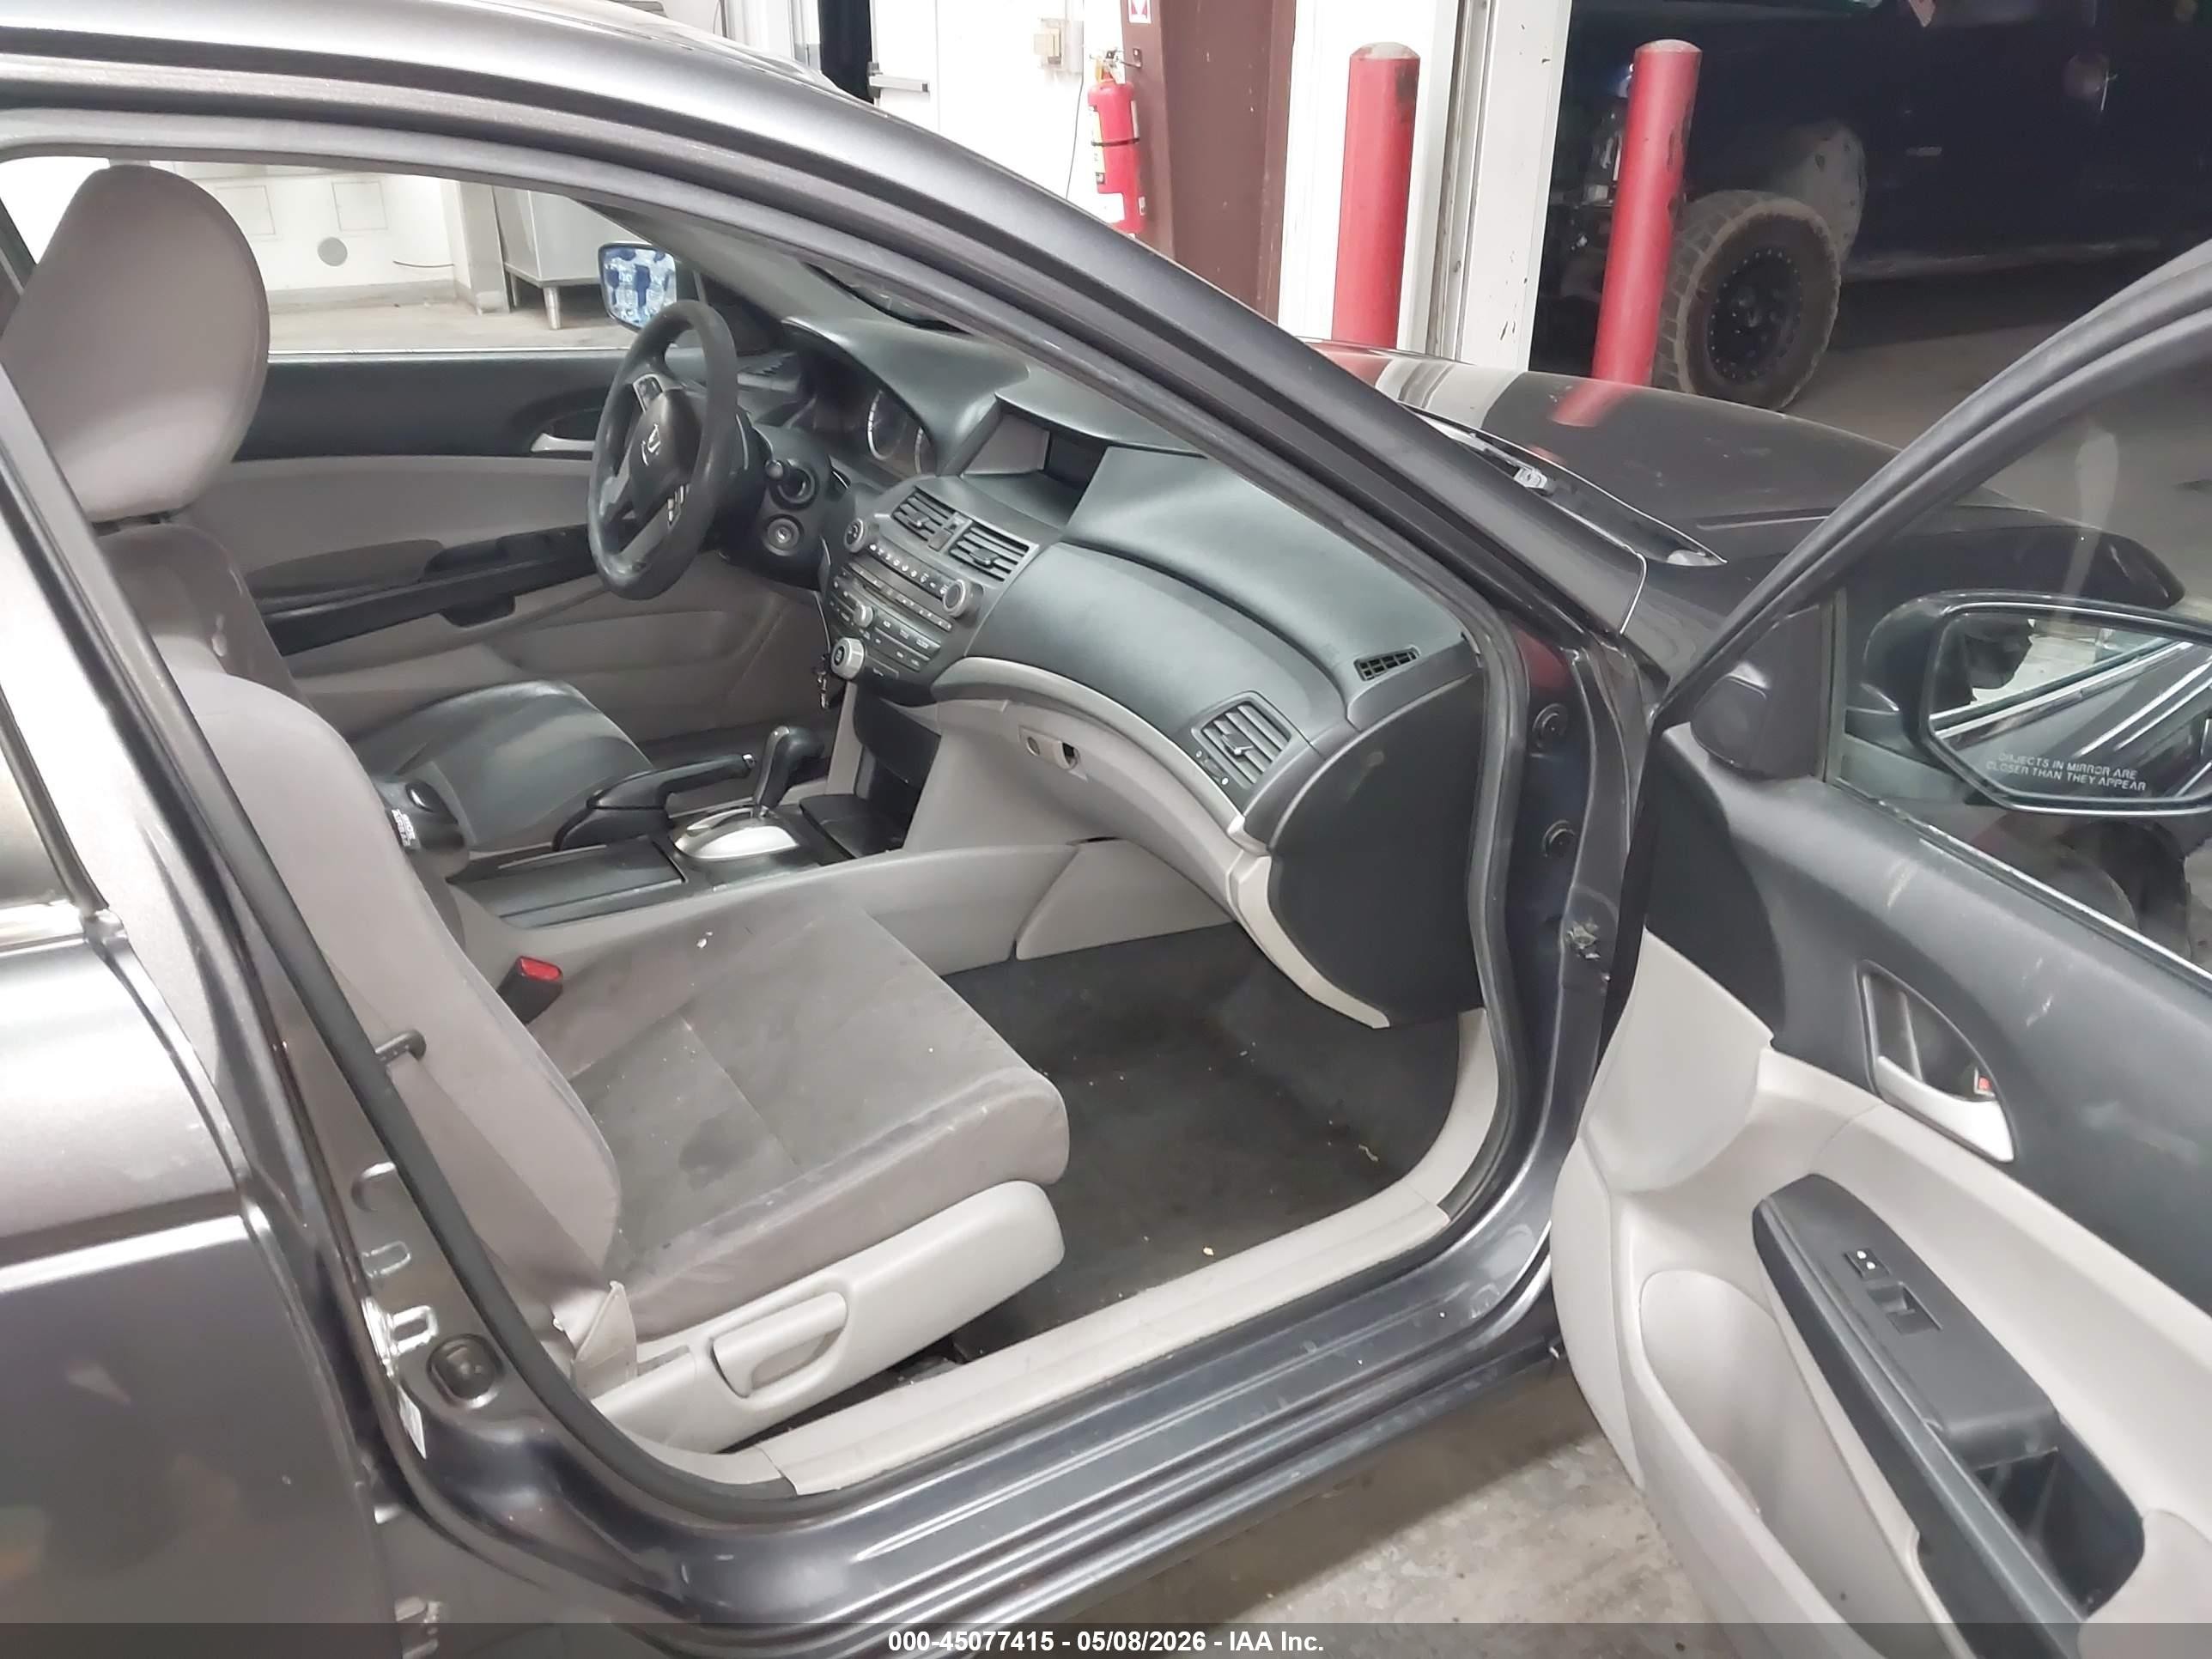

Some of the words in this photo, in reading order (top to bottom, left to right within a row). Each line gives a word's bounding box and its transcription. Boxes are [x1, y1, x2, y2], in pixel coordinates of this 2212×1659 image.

[1985, 760, 2029, 775] CLOSER
[2032, 767, 2062, 780] THAN
[2066, 771, 2095, 784] THEY
[2098, 775, 2147, 791] APPEAR
[2052, 760, 2063, 769] IN
[2067, 762, 2110, 776] MIRROR
[2112, 769, 2137, 780] ARE
